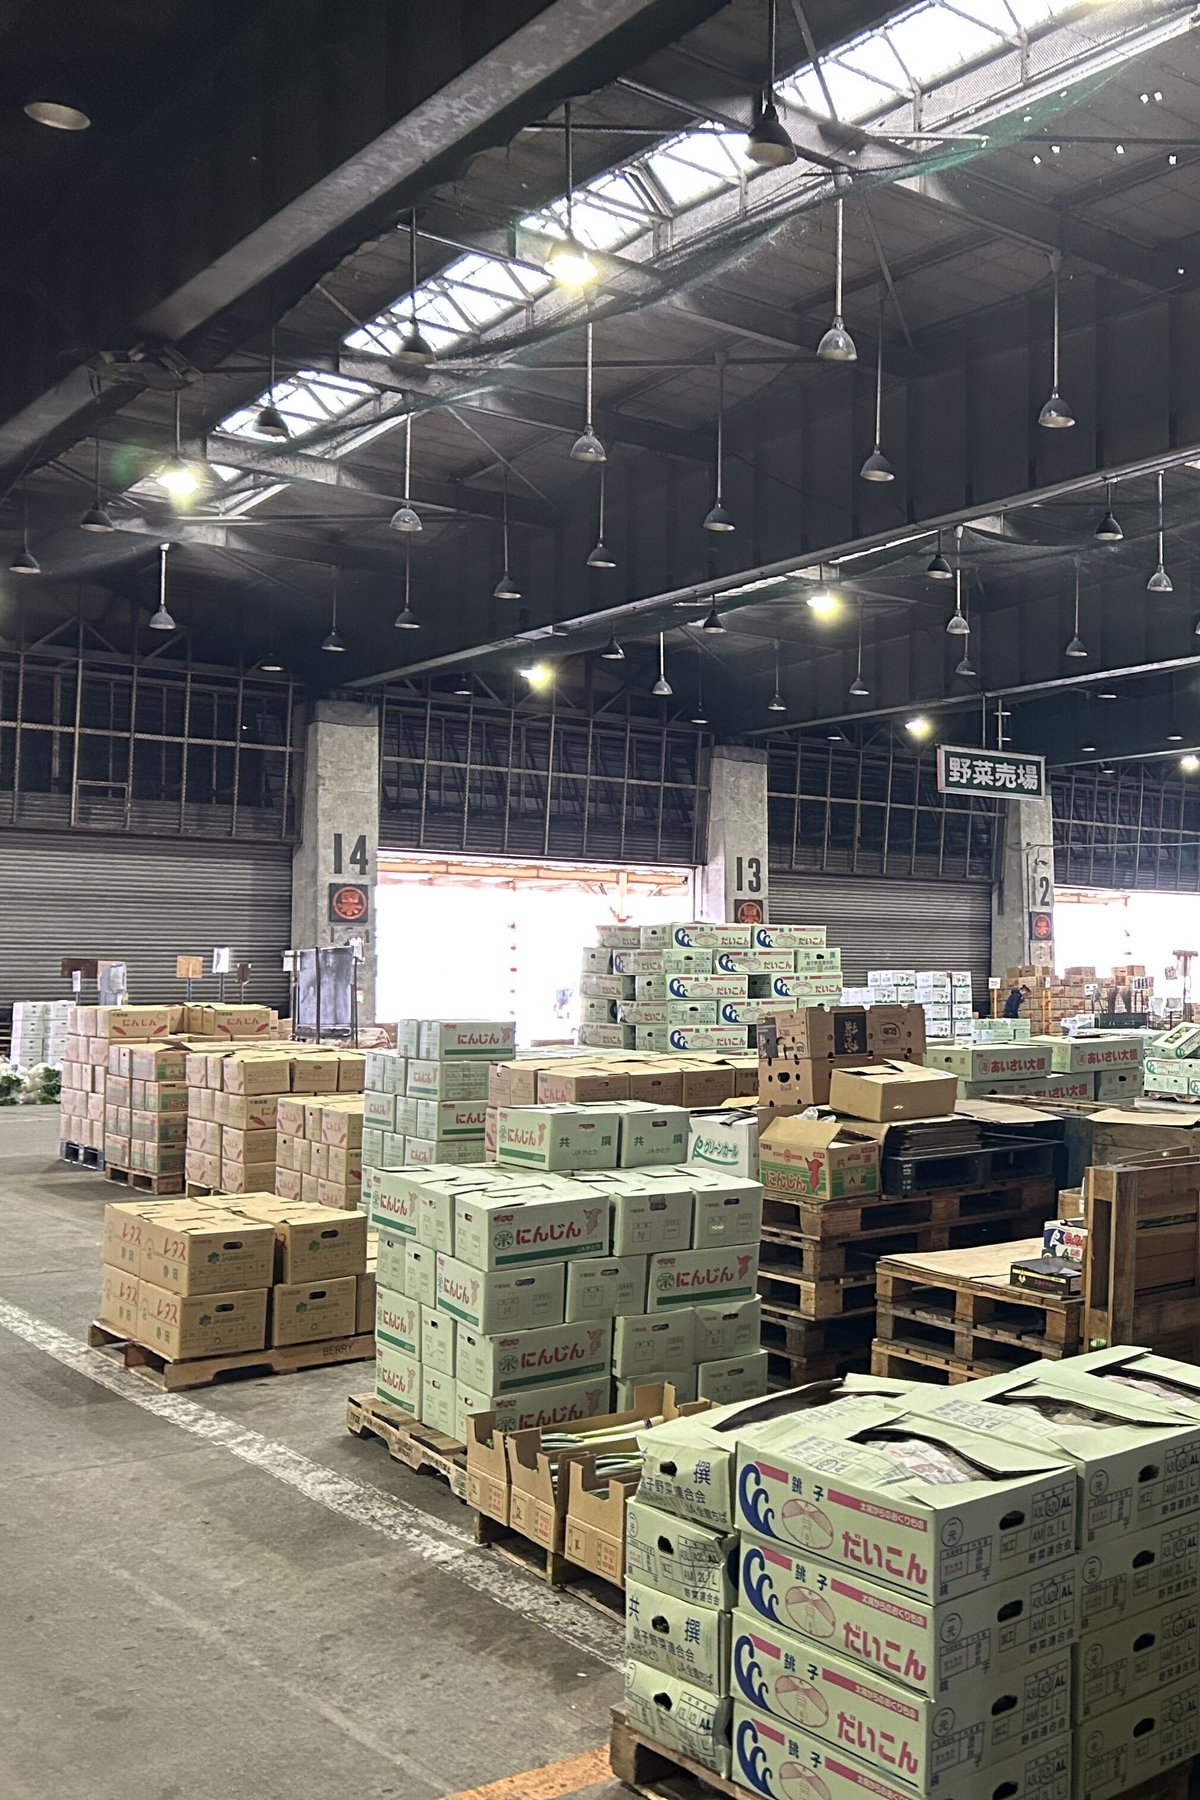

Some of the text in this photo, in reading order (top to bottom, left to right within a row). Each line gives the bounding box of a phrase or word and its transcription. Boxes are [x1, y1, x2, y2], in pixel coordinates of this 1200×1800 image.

[948, 757, 1039, 791] 野菜売場
[334, 833, 369, 875] 14
[736, 856, 762, 893] 13
[763, 960, 793, 970] だいこん
[716, 986, 747, 996] だいこん
[122, 1018, 157, 1027] にんじん
[457, 1033, 499, 1045] にんじん
[716, 1036, 747, 1046] だいこん
[991, 1058, 1045, 1073] あいさい大根
[1087, 1050, 1138, 1063] あいさい大根
[507, 1127, 536, 1146] にんじん
[559, 1137, 570, 1149] 共
[633, 1135, 644, 1147] 共
[765, 1169, 807, 1192] にんじん
[380, 1195, 408, 1217] にんじん
[515, 1220, 582, 1245] にんじん
[163, 1237, 187, 1262] レタス
[676, 1267, 733, 1288] にんじん
[443, 1278, 470, 1305] にんじん
[156, 1299, 178, 1324] レタス
[383, 1308, 407, 1334] にんじん
[323, 1344, 354, 1357] BERRY
[521, 1342, 585, 1369] にんじん
[382, 1366, 406, 1392] にんじん
[518, 1402, 584, 1430] にんじん
[1189, 1454, 1199, 1465] AL
[693, 1459, 711, 1486] 撰
[791, 1475, 824, 1502] 銚子
[1060, 1496, 1072, 1509] AL
[1187, 1536, 1197, 1548] AL
[841, 1530, 928, 1586] だいこん
[795, 1563, 828, 1592] 銚子
[1061, 1584, 1073, 1598] AL
[628, 1596, 700, 1646] 共 撰
[842, 1621, 927, 1681] だいこん
[784, 1652, 819, 1681] 銚子
[1054, 1674, 1066, 1689] AL
[788, 1738, 822, 1769] 銚子
[836, 1711, 919, 1774] だいこん
[1055, 1759, 1067, 1772] AL
